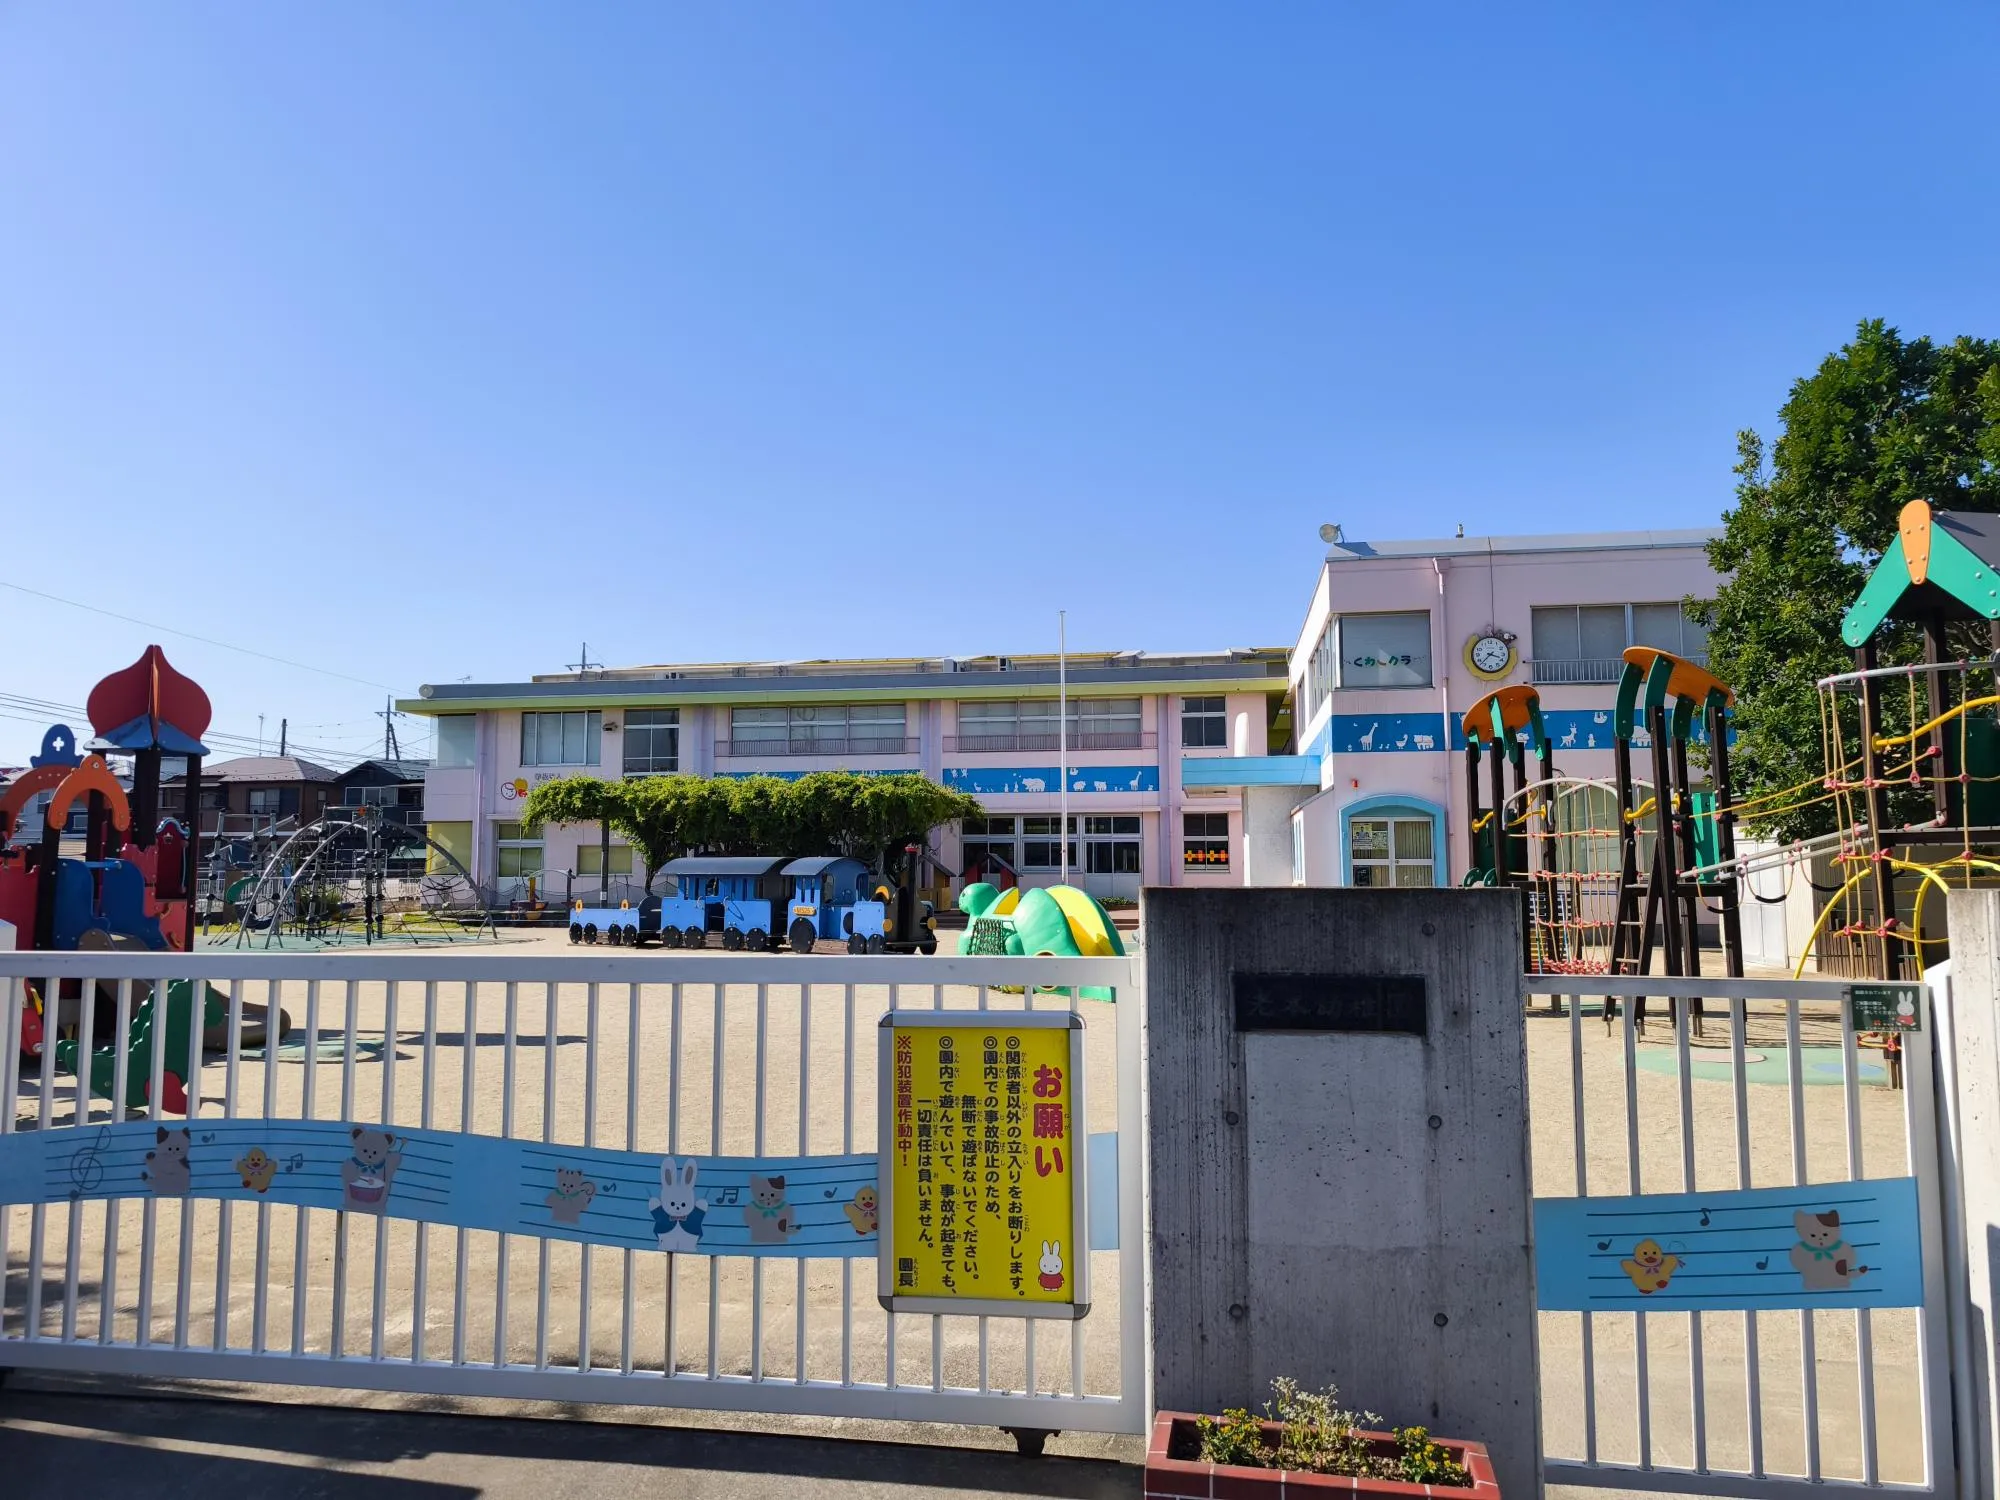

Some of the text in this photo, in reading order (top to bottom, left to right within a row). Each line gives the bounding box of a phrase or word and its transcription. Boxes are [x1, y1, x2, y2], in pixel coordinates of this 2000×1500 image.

[917, 1099, 934, 1248] 一切責任は負いません。
[1032, 1063, 1064, 1177] お願い
[961, 1094, 979, 1280] 無断で遊ばないでください。
[898, 1257, 914, 1287] 園長
